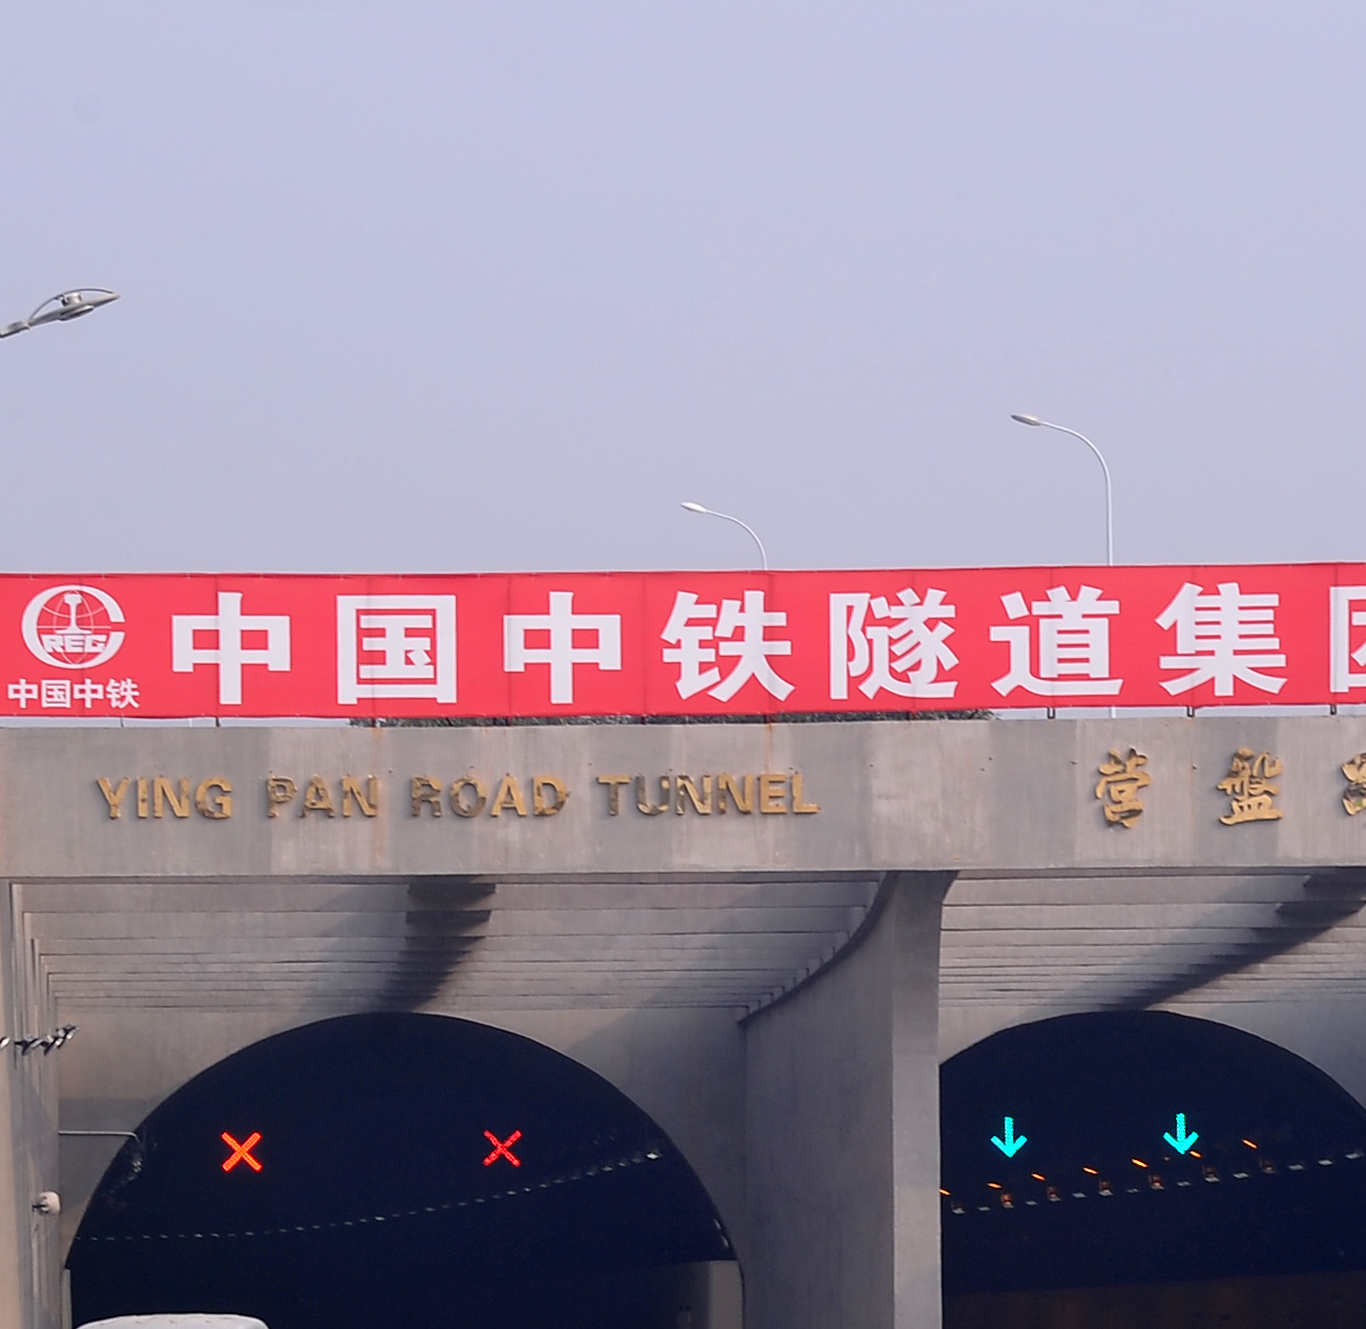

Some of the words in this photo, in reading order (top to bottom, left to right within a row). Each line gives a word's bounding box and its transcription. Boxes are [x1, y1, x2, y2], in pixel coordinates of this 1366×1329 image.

[7, 677, 141, 709] 中国中铁
[97, 775, 233, 819] YING
[266, 773, 379, 819] PAN
[411, 773, 568, 818] ROAD
[597, 770, 820, 817] TUNNEL
